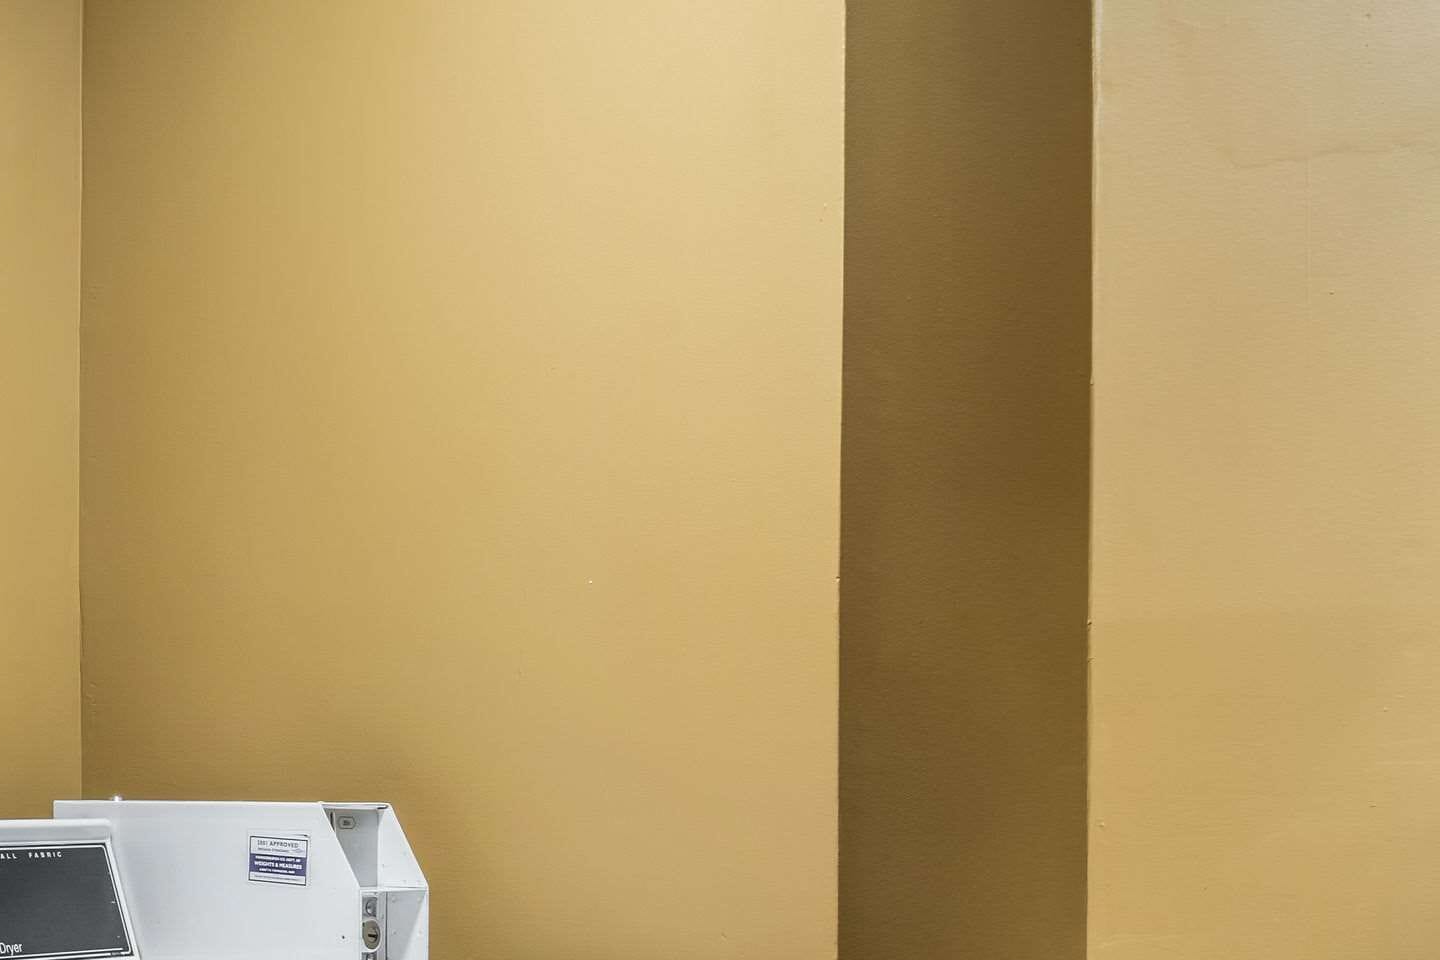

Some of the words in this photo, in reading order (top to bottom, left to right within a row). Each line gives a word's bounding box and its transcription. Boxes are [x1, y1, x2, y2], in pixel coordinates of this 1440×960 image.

[0, 852, 18, 860] ALL
[28, 851, 62, 859] FABRIC
[0, 942, 23, 956] Dryer
